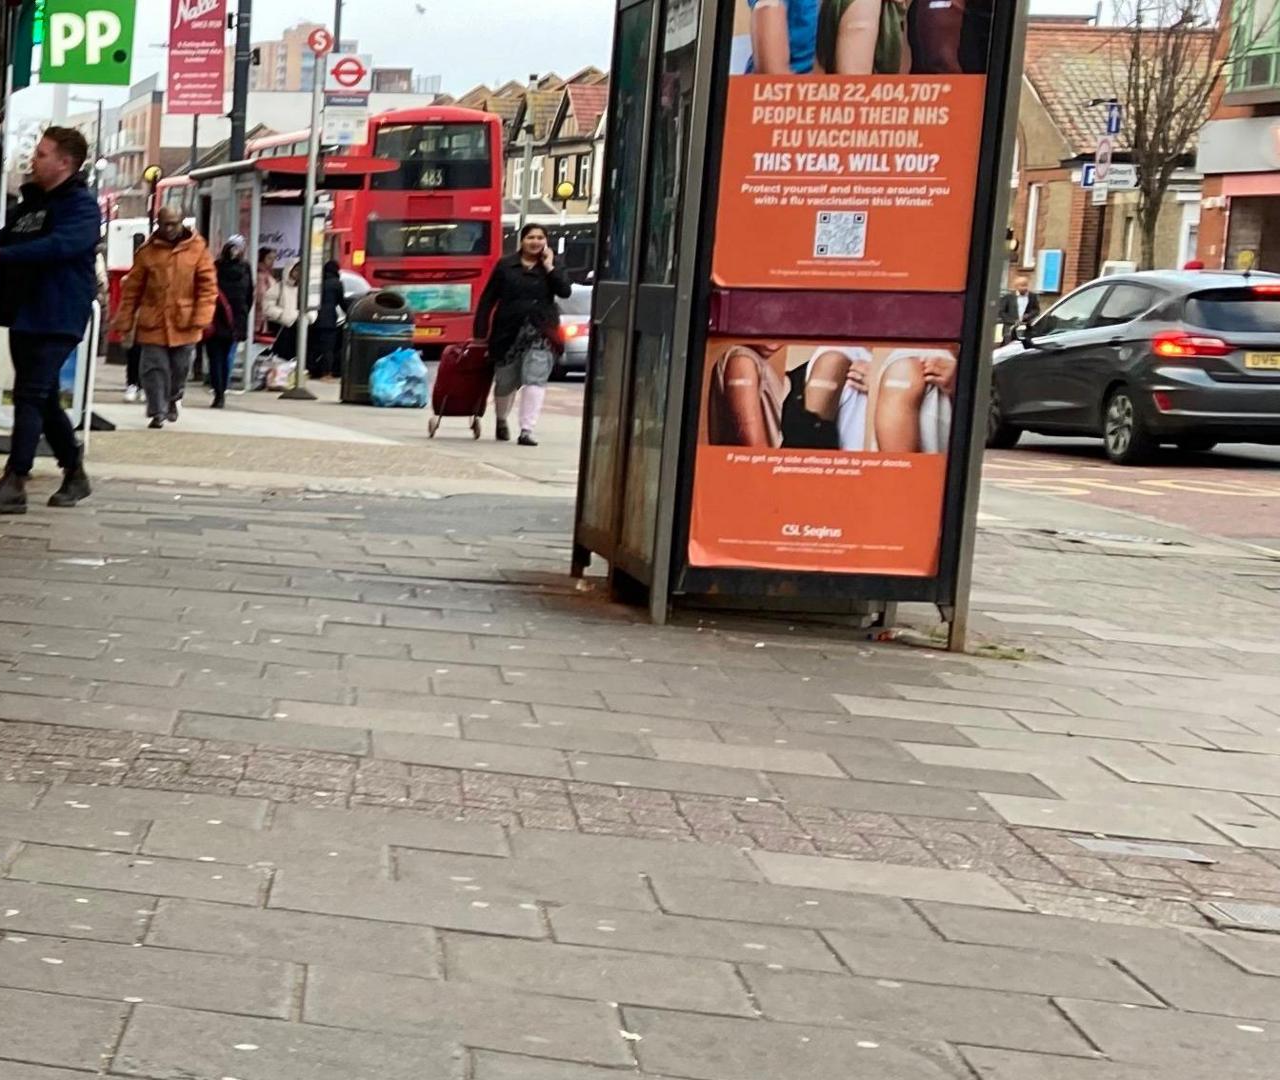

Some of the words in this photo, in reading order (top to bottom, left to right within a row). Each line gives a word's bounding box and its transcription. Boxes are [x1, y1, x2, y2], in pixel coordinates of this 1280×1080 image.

[313, 30, 327, 50] S
[753, 83, 793, 101] LAST
[797, 83, 840, 101] YEAR
[752, 106, 816, 125] PEOPLE
[820, 106, 855, 125] HAD
[860, 106, 910, 125] THEIR
[913, 106, 949, 125] NHS
[772, 129, 803, 148] FLU
[807, 129, 924, 148] VACCINATION.
[753, 153, 792, 172] THIS
[795, 153, 845, 174] YEAR,
[848, 153, 890, 172] WILL
[895, 153, 940, 172] YOU?
[741, 183, 781, 194] Protect
[783, 184, 828, 196] yourself
[830, 184, 850, 194] and
[853, 184, 883, 194] those
[885, 184, 927, 195] around
[928, 187, 950, 197] you
[754, 196, 778, 205] with
[790, 196, 804, 206] flu
[806, 196, 869, 206] vaccination
[871, 196, 893, 206] this
[894, 197, 934, 207] Winter.
[734, 455, 749, 463] you
[751, 454, 766, 464] get
[767, 456, 783, 465] any
[851, 457, 860, 466] to
[781, 524, 801, 536] CSL
